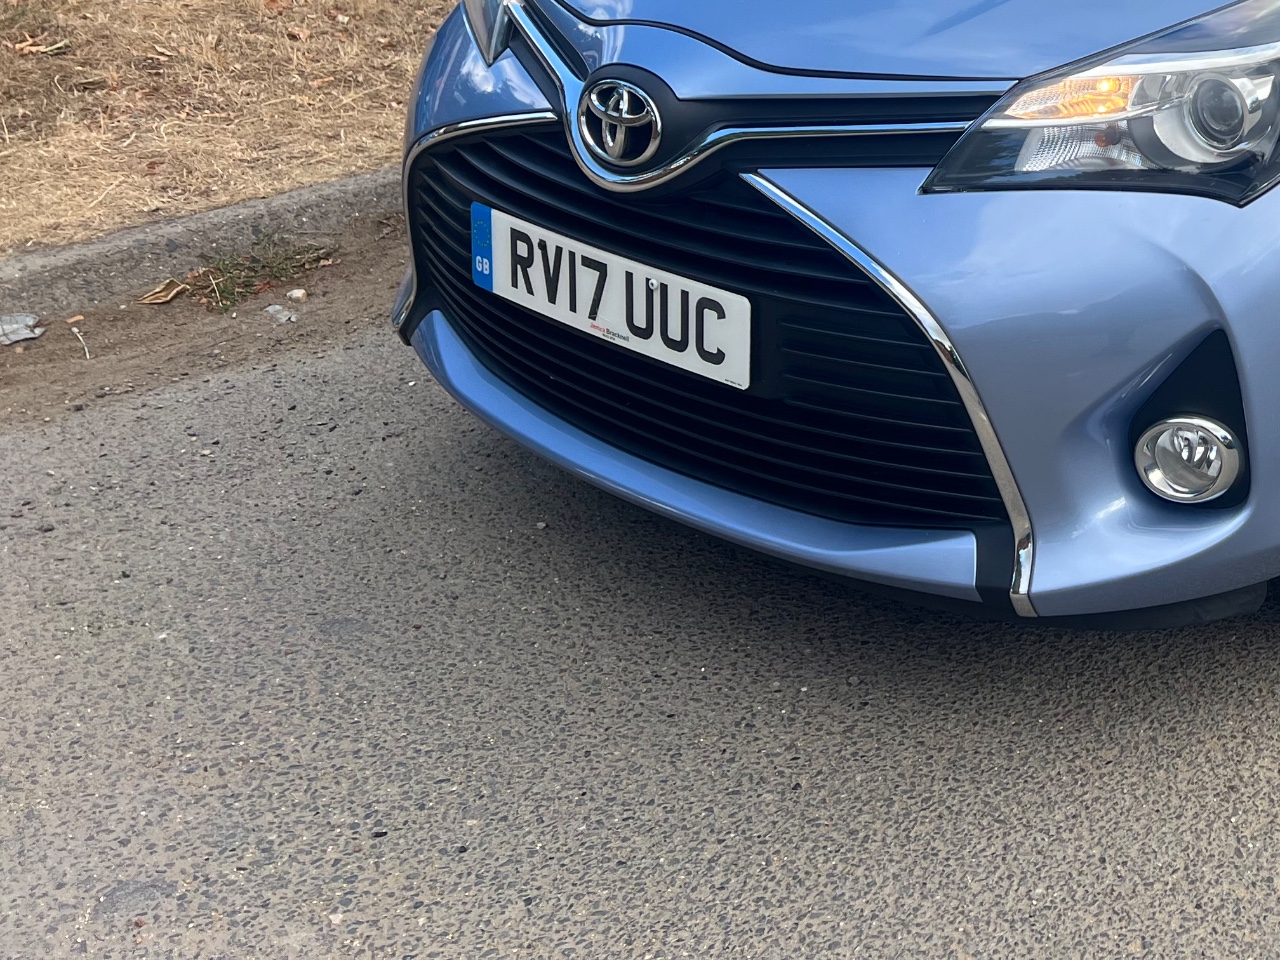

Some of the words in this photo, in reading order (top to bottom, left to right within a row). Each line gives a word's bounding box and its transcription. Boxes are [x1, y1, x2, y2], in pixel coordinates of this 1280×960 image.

[475, 255, 490, 275] GB
[510, 226, 608, 322] RV17
[625, 270, 727, 366] UUC
